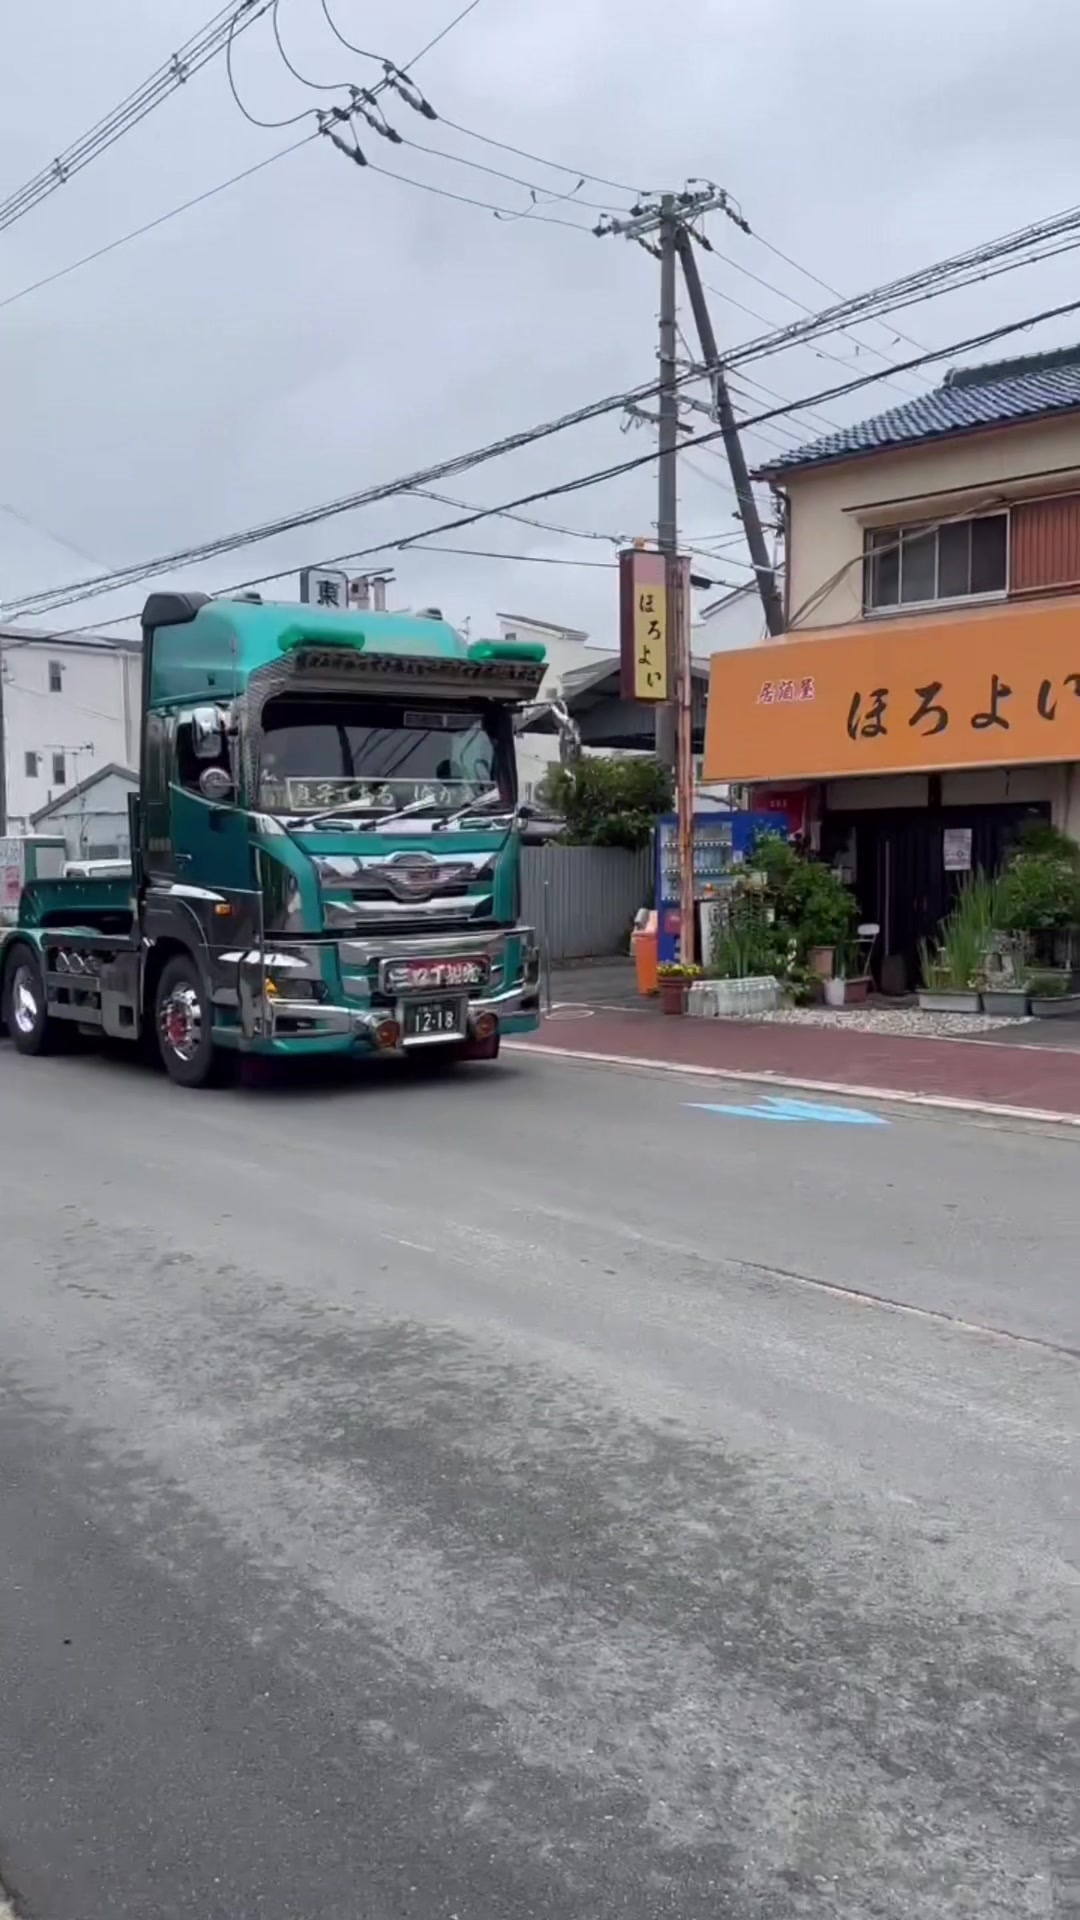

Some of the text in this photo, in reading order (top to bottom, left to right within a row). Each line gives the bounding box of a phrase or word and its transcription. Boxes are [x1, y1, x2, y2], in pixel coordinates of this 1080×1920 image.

[638, 593, 662, 688] ほろよい
[756, 676, 815, 704] 居酒屋
[846, 673, 1080, 740] ほろよい
